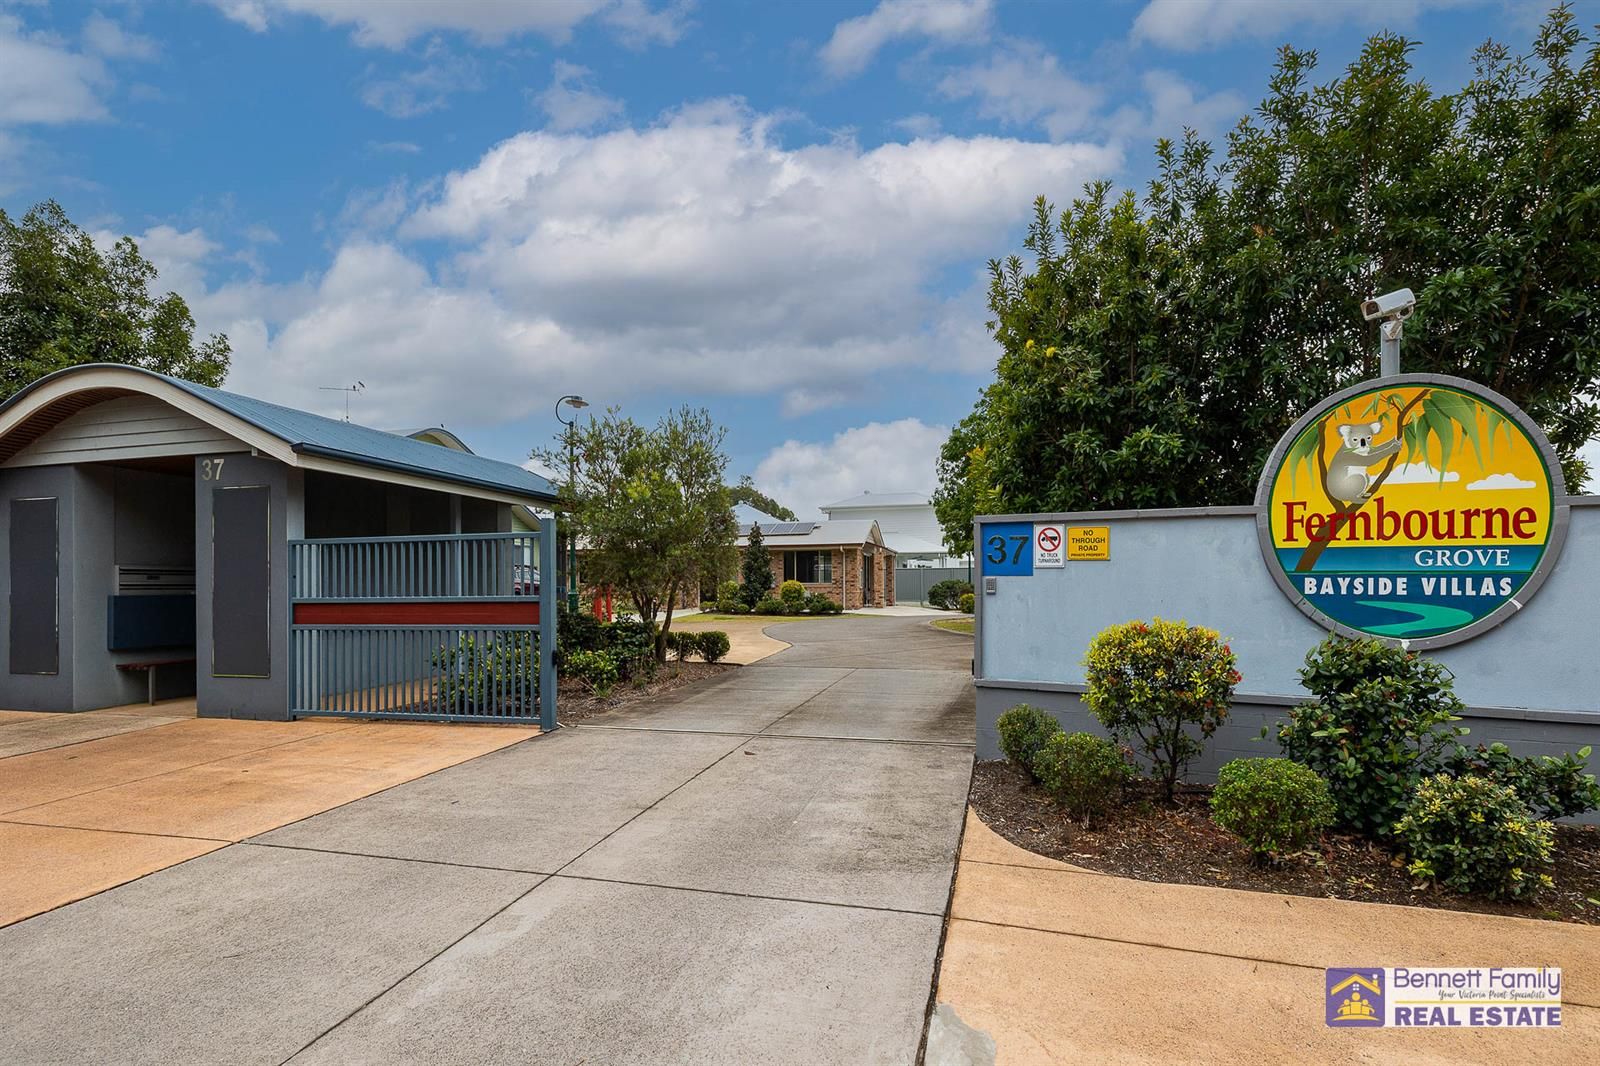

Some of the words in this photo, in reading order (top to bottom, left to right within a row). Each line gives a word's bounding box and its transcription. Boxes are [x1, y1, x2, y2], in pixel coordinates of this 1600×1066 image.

[201, 458, 225, 481] 37
[1282, 496, 1537, 543] Fernbourne
[987, 534, 1030, 565] 37
[1414, 549, 1510, 567] GROVE
[1304, 577, 1408, 596] BAYSIDE
[1422, 577, 1513, 597] VILLAS
